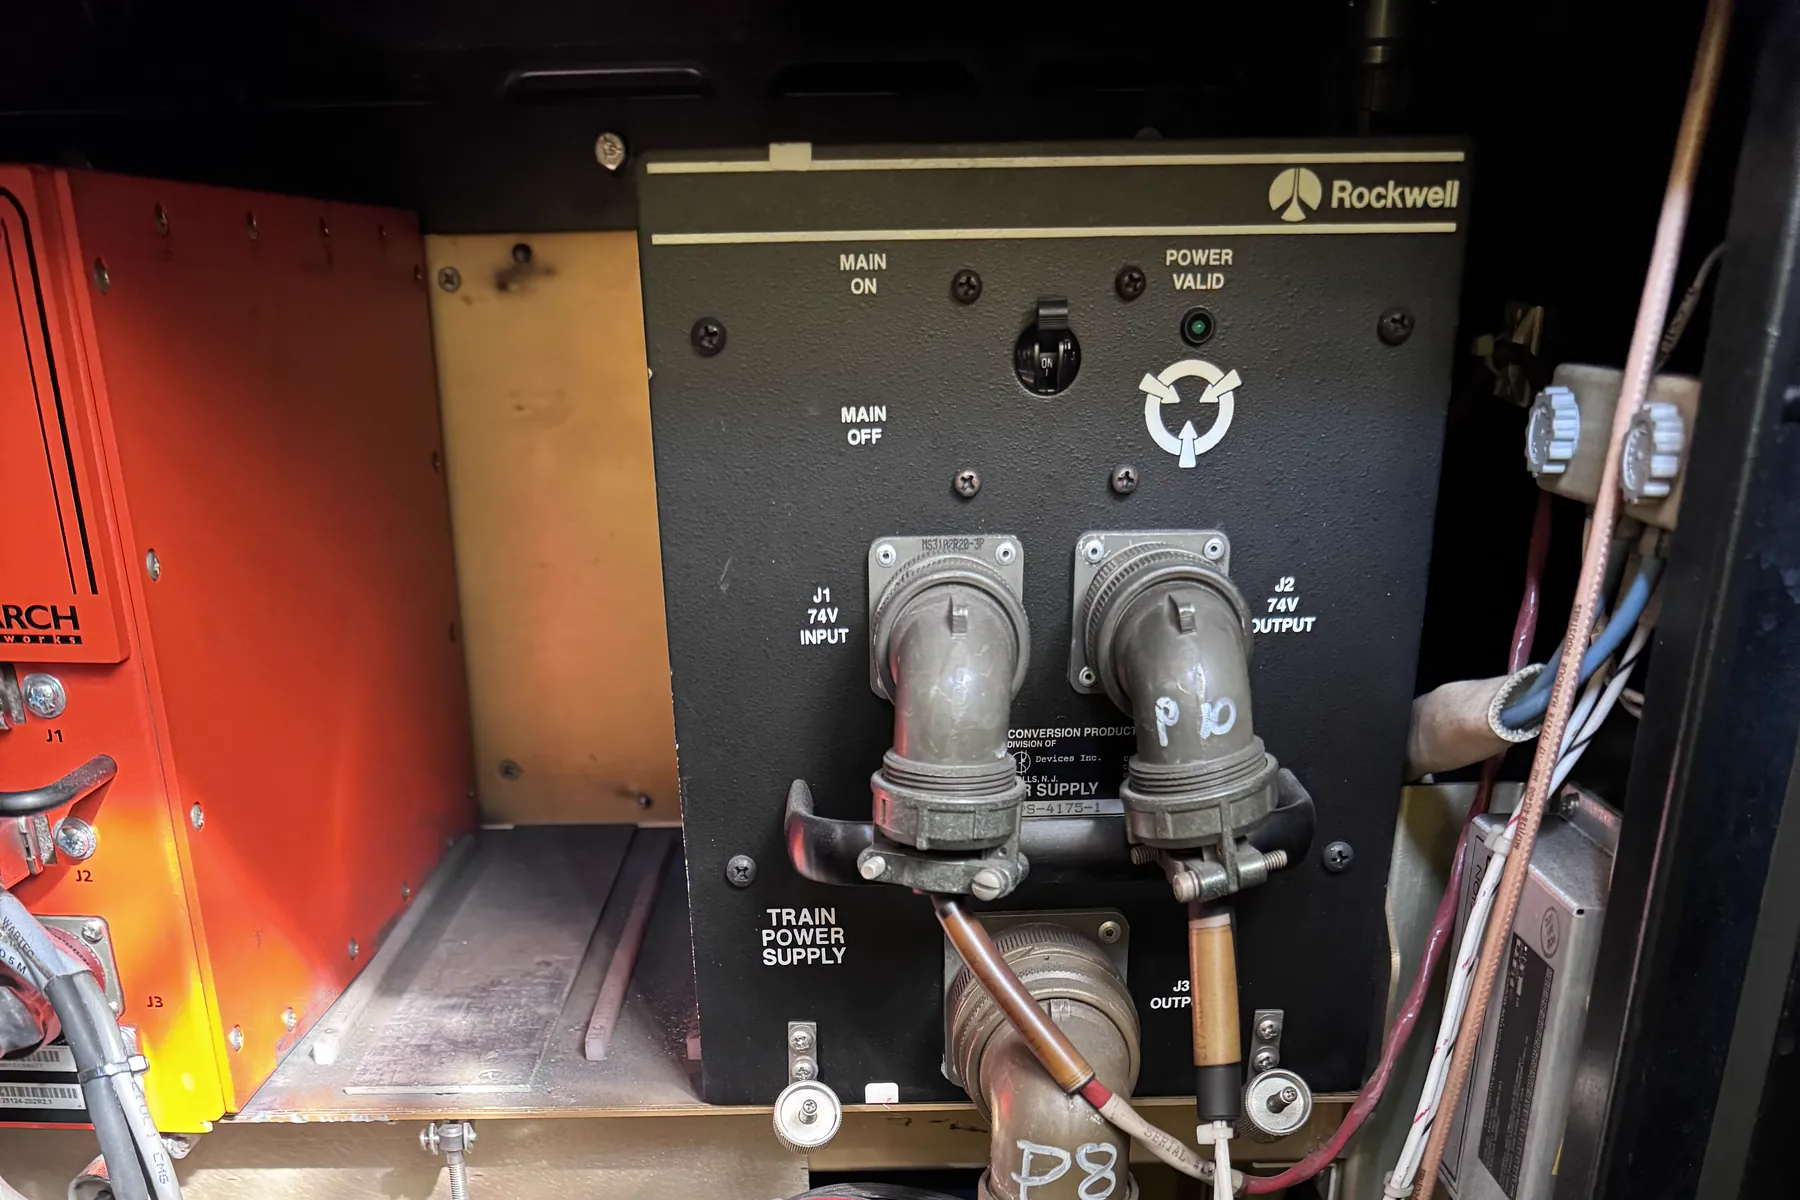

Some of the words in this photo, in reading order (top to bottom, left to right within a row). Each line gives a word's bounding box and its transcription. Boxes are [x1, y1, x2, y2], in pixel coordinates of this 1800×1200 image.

[1331, 180, 1460, 209] Rockwell
[840, 254, 887, 271] MAIN
[1166, 249, 1232, 266] POWER
[850, 278, 878, 295] ON
[1173, 273, 1225, 291] VALID
[1041, 358, 1053, 370] ON
[841, 406, 887, 424] MAIN
[847, 430, 882, 446] OFF
[1274, 576, 1295, 592] J2
[812, 587, 831, 603] J1
[1267, 597, 1299, 613] 74V
[0, 604, 81, 631] RCH
[807, 608, 838, 624] 74V
[800, 629, 849, 645] INPUT
[1548, 660, 1569, 708] HARBOUR
[46, 729, 63, 743] J1
[1008, 728, 1081, 739] CONVERSION
[1007, 740, 1043, 749] DIVISION
[1045, 740, 1057, 748] OF
[1036, 755, 1075, 763] Devices
[1036, 782, 1099, 797] SUPPLY
[76, 870, 93, 883] J2
[766, 907, 836, 926] TRAIN
[2, 915, 35, 959] WABTEC
[762, 927, 845, 947] POWER
[762, 947, 847, 966] SUPPLY
[1173, 980, 1190, 992] J3
[147, 996, 164, 1008] J3
[1143, 1125, 1187, 1163] SERIAL
